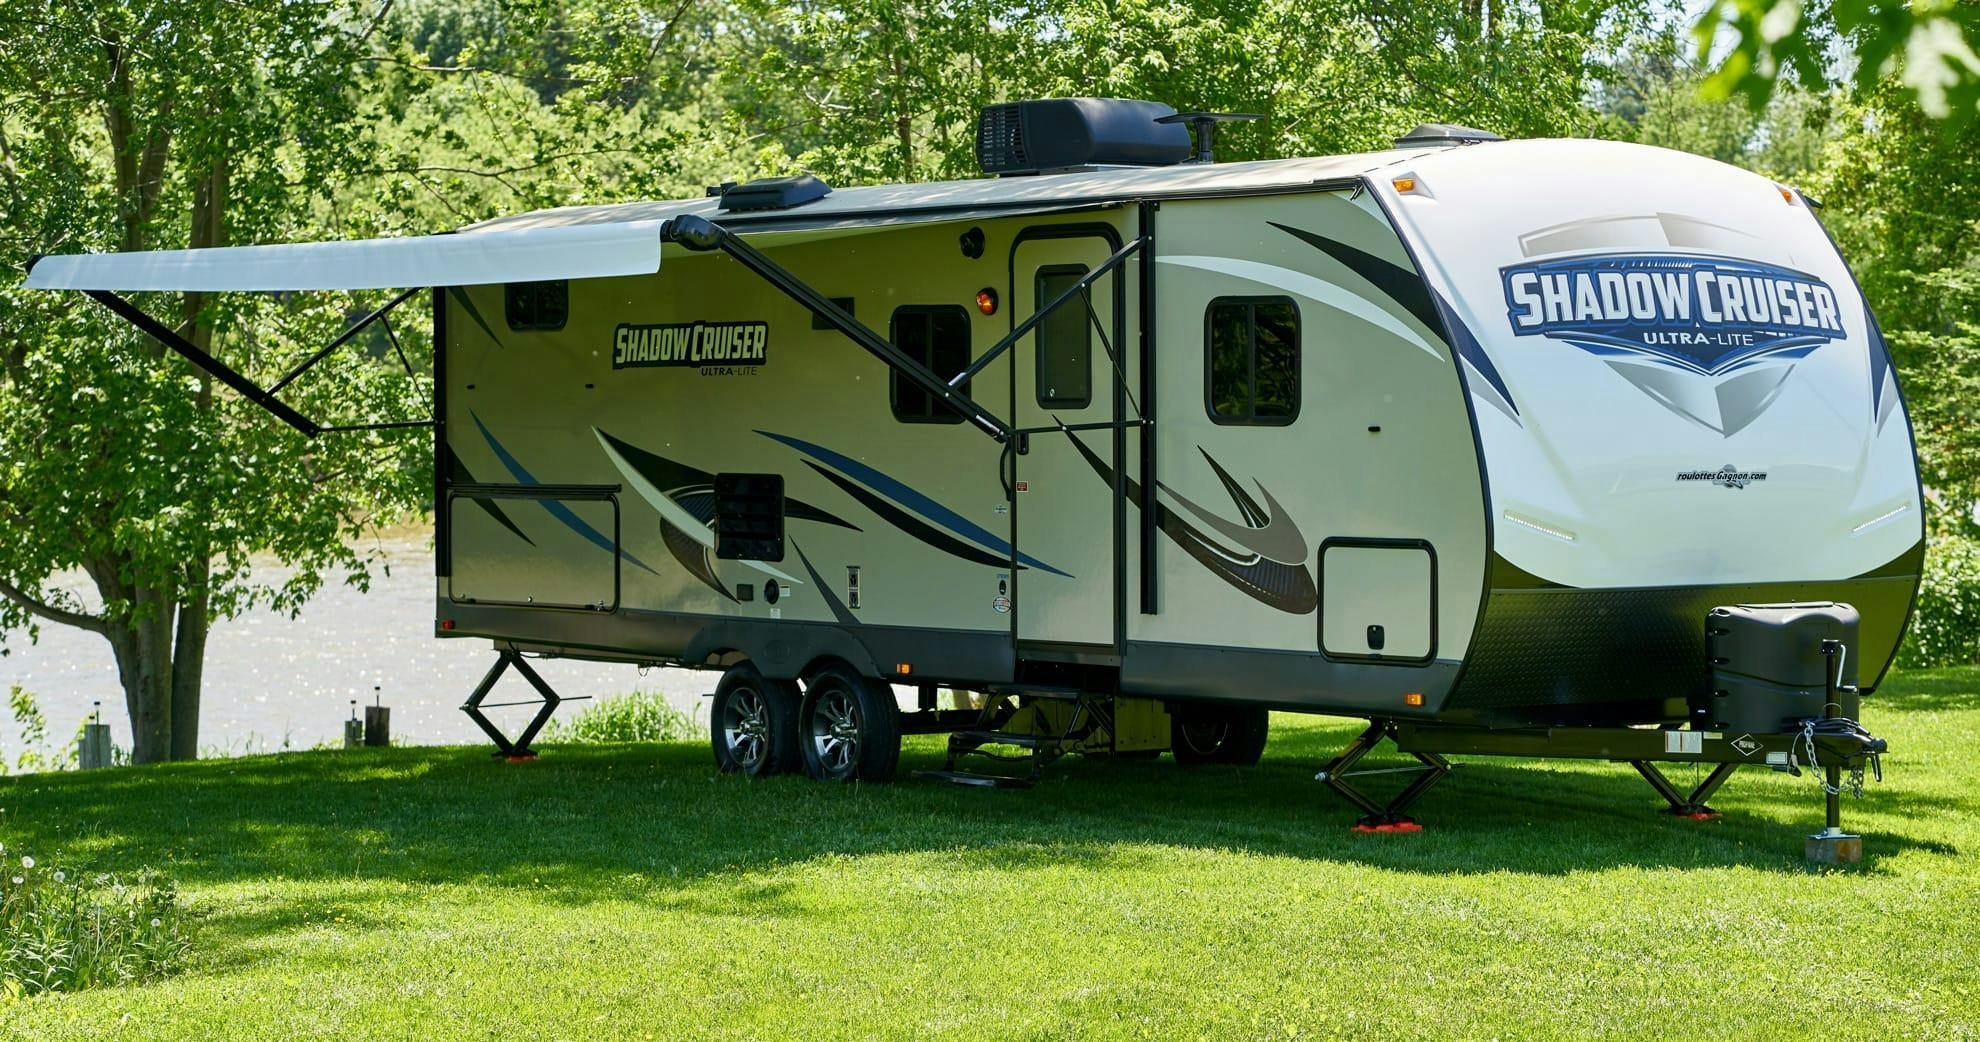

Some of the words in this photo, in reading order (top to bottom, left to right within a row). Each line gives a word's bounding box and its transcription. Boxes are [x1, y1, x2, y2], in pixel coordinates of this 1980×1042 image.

[1511, 271, 1690, 327] SHADOW
[1695, 270, 1841, 331] CRUISER
[615, 327, 691, 364] SHADOW
[691, 325, 766, 362] CRUISER
[1643, 331, 1754, 347] ULTRA-LITE
[701, 366, 757, 377] ULTRA-LITE
